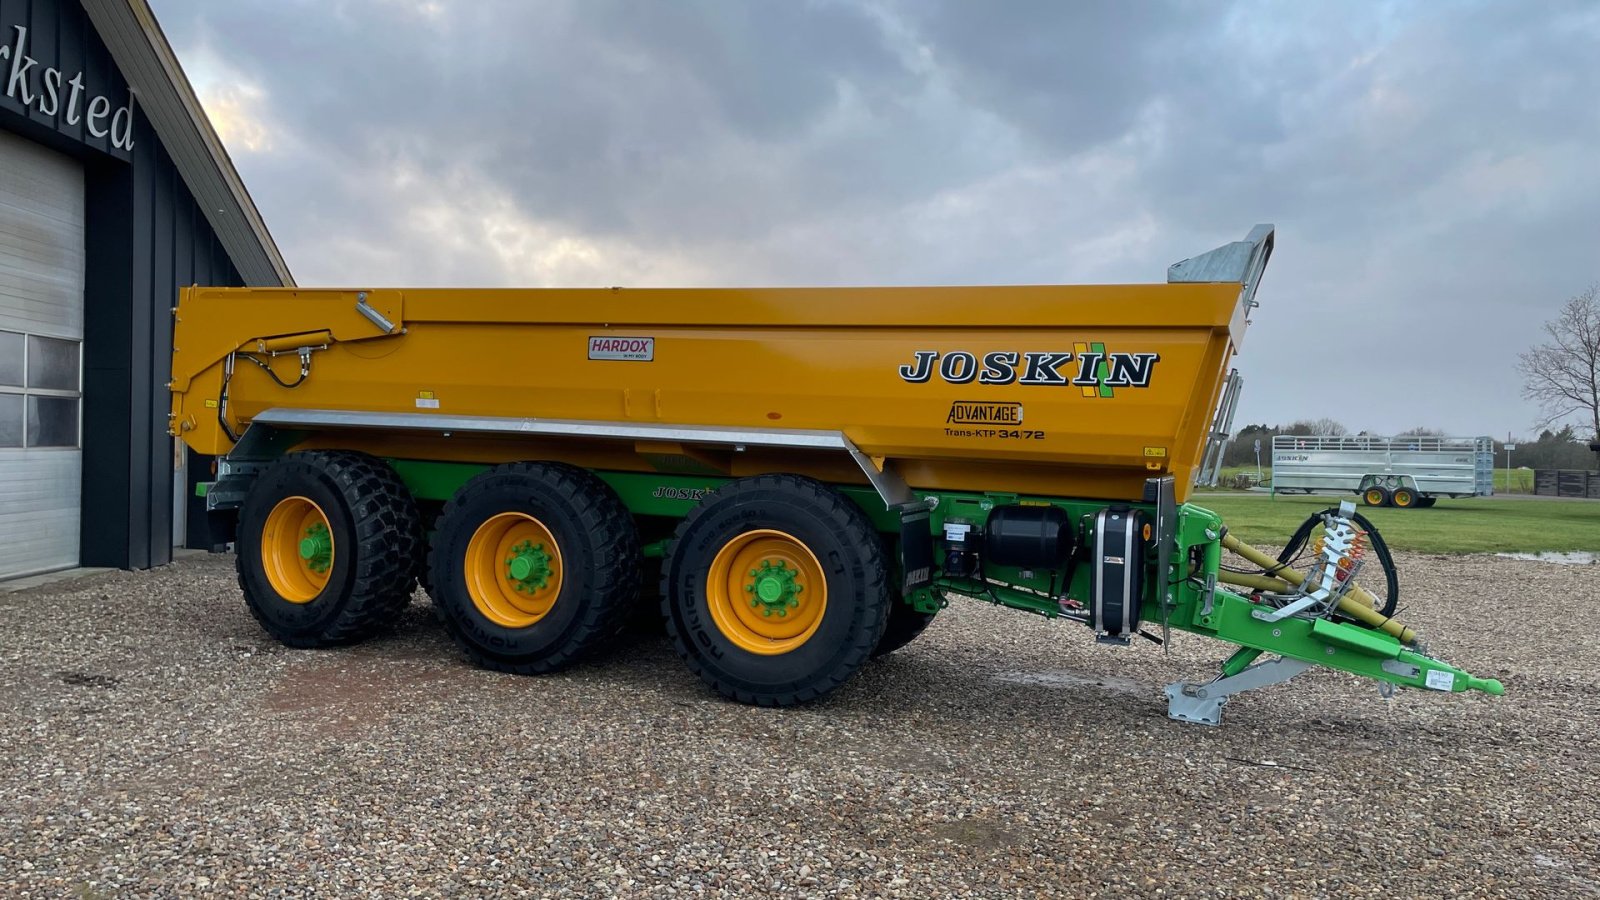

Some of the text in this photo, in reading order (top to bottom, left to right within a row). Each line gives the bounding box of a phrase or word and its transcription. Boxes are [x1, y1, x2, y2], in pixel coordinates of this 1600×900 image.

[0, 25, 135, 151] ksted
[592, 340, 649, 353] HARDOX
[899, 351, 1160, 388] JOSKIN
[946, 405, 1017, 424] ADVANTAGE
[944, 428, 1045, 440] Trans-KTP 34/72
[652, 487, 720, 501] JOSK
